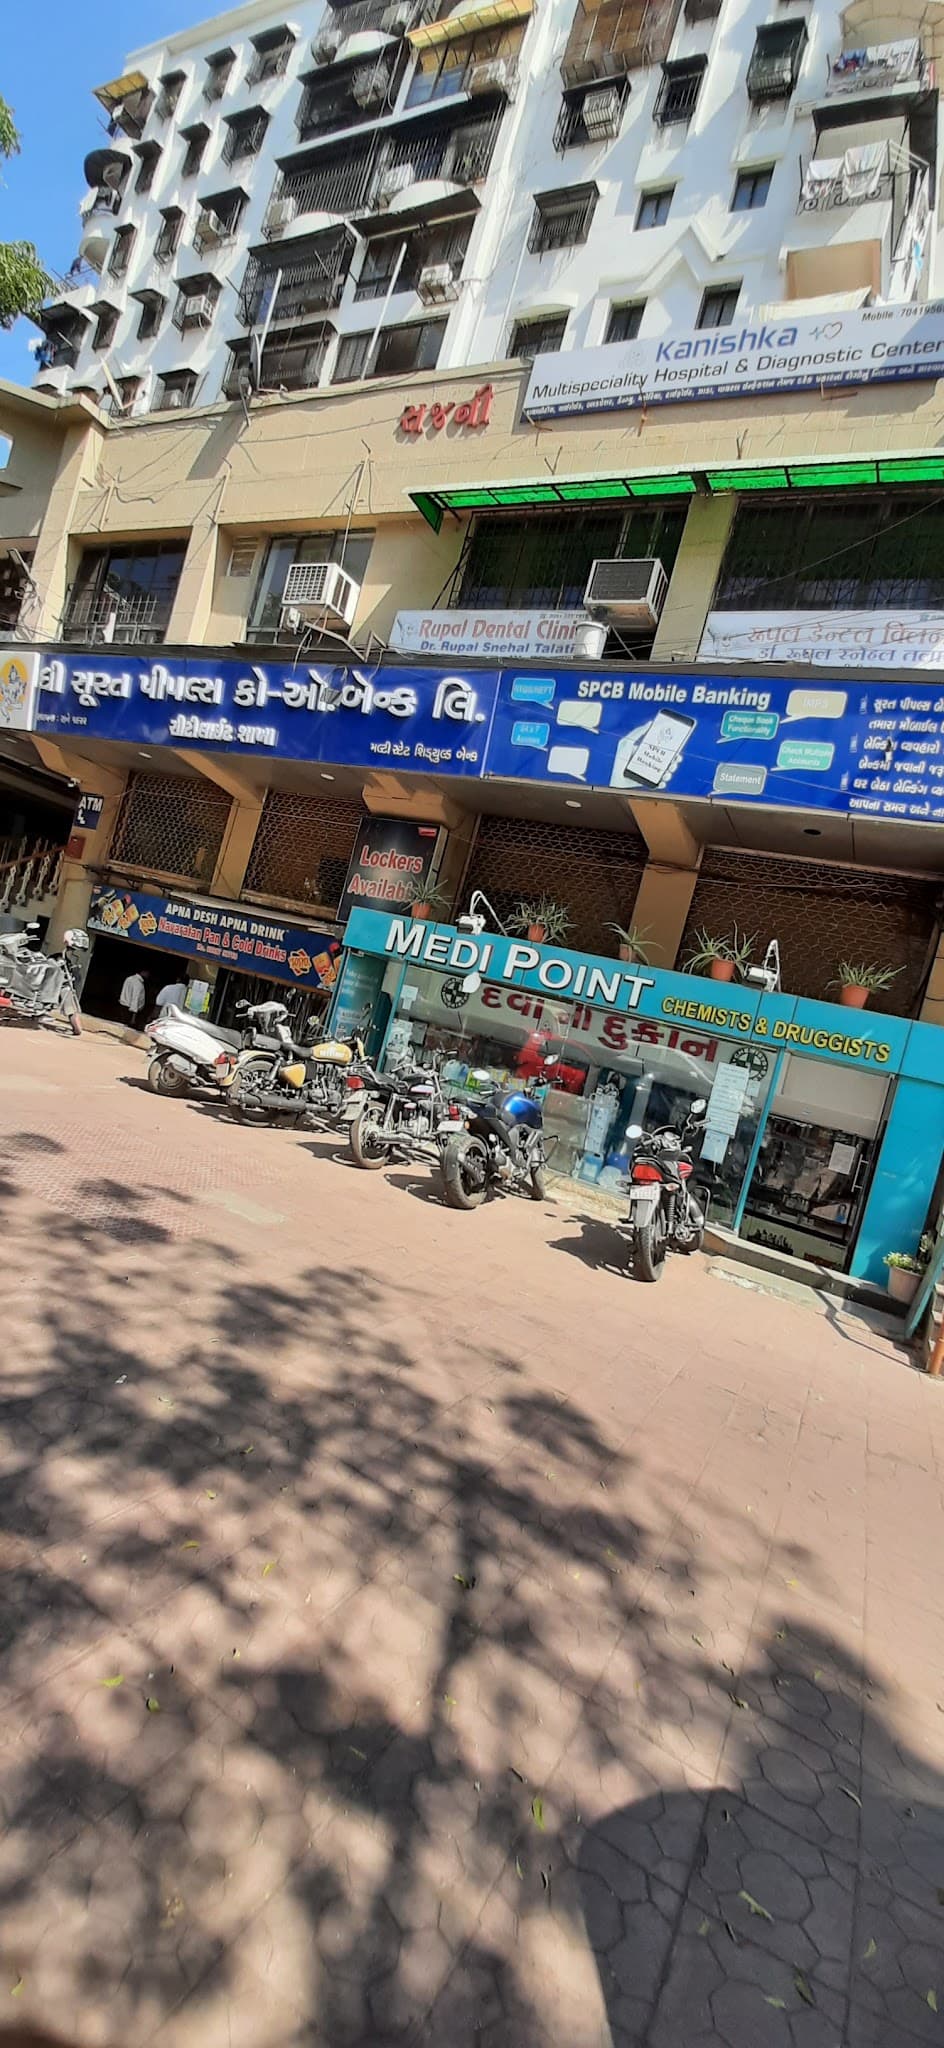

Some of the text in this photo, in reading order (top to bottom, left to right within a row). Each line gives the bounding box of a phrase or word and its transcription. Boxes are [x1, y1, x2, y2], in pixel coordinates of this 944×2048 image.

[655, 326, 799, 363] Kanishka
[532, 372, 649, 399] Multispeciality
[654, 361, 729, 383] Hospital
[735, 358, 748, 373] &
[756, 346, 863, 372] Diagnostic
[871, 340, 944, 359] Center
[419, 619, 578, 640] Rupal Dental Clini
[420, 641, 576, 655] Dr. Rupal Snehal Talati
[139, 664, 224, 705] પીપલ્સ
[577, 680, 772, 712] SPCB Mobile Banking
[719, 772, 761, 785] Statement
[78, 795, 103, 812] ATM
[360, 844, 423, 873] Lockers
[165, 903, 286, 942] APNA DESH APNA DRINK
[203, 927, 221, 946] Pan
[222, 931, 230, 948] &
[232, 934, 255, 954] Cold
[255, 940, 287, 963] Drinks
[384, 919, 494, 973] MEDI
[502, 943, 655, 1010] POINT
[662, 997, 891, 1062] CHEMISTS & DRUGGISTS
